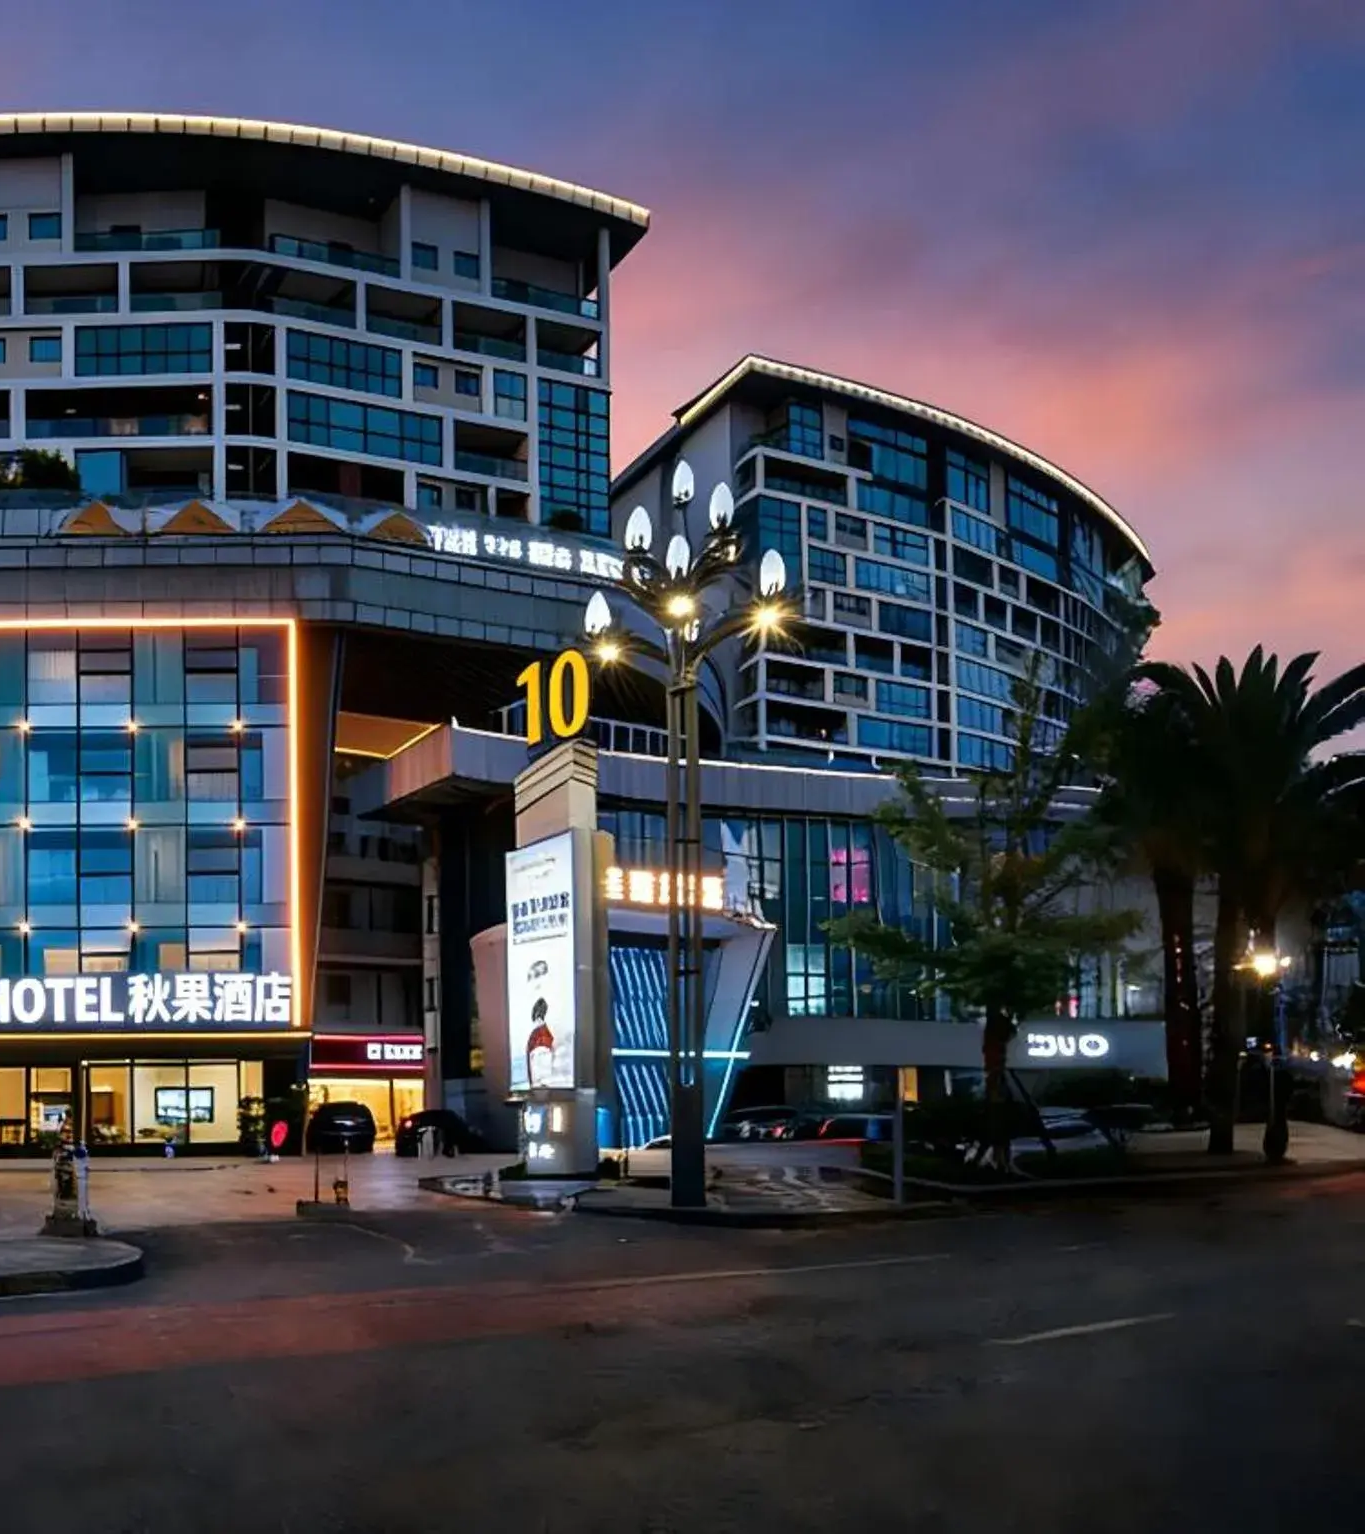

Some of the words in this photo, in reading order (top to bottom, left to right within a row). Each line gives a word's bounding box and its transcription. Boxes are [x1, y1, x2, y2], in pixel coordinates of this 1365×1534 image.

[516, 649, 590, 746] 10
[127, 972, 292, 1023] 秋果酒店
